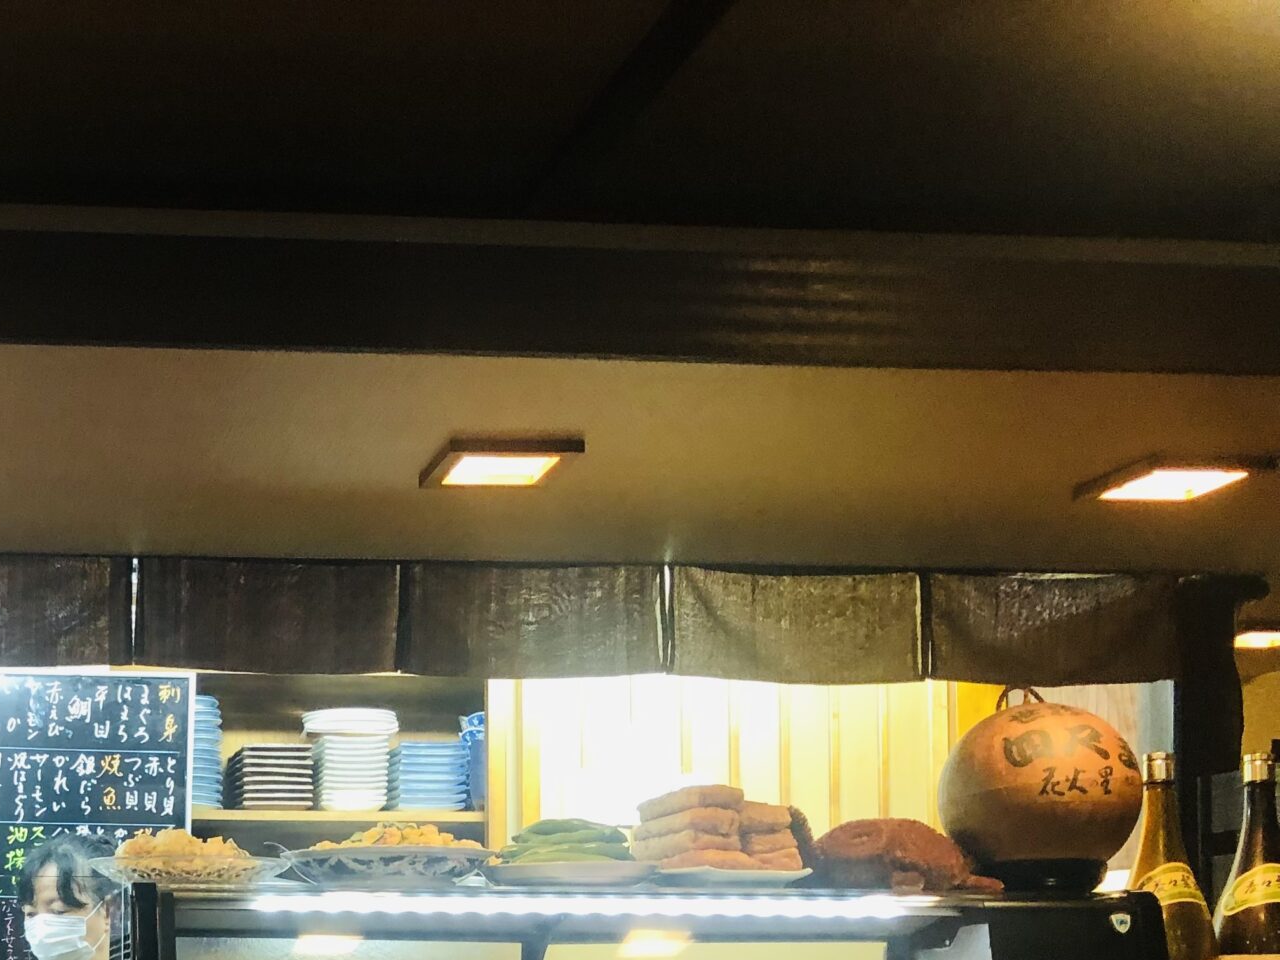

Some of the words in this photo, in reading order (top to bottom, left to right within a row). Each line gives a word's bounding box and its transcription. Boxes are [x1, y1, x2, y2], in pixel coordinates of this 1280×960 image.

[66, 695, 91, 723] 鯛
[133, 684, 151, 743] まぐろ
[158, 683, 181, 743] 刺身
[29, 753, 50, 817] サーモン
[52, 755, 70, 813] かれい
[69, 753, 98, 816] 銀だら
[96, 753, 124, 811] 焼魚
[123, 757, 142, 811] つぶ貝
[144, 756, 164, 813] 赤貝
[160, 756, 177, 816] とり貝
